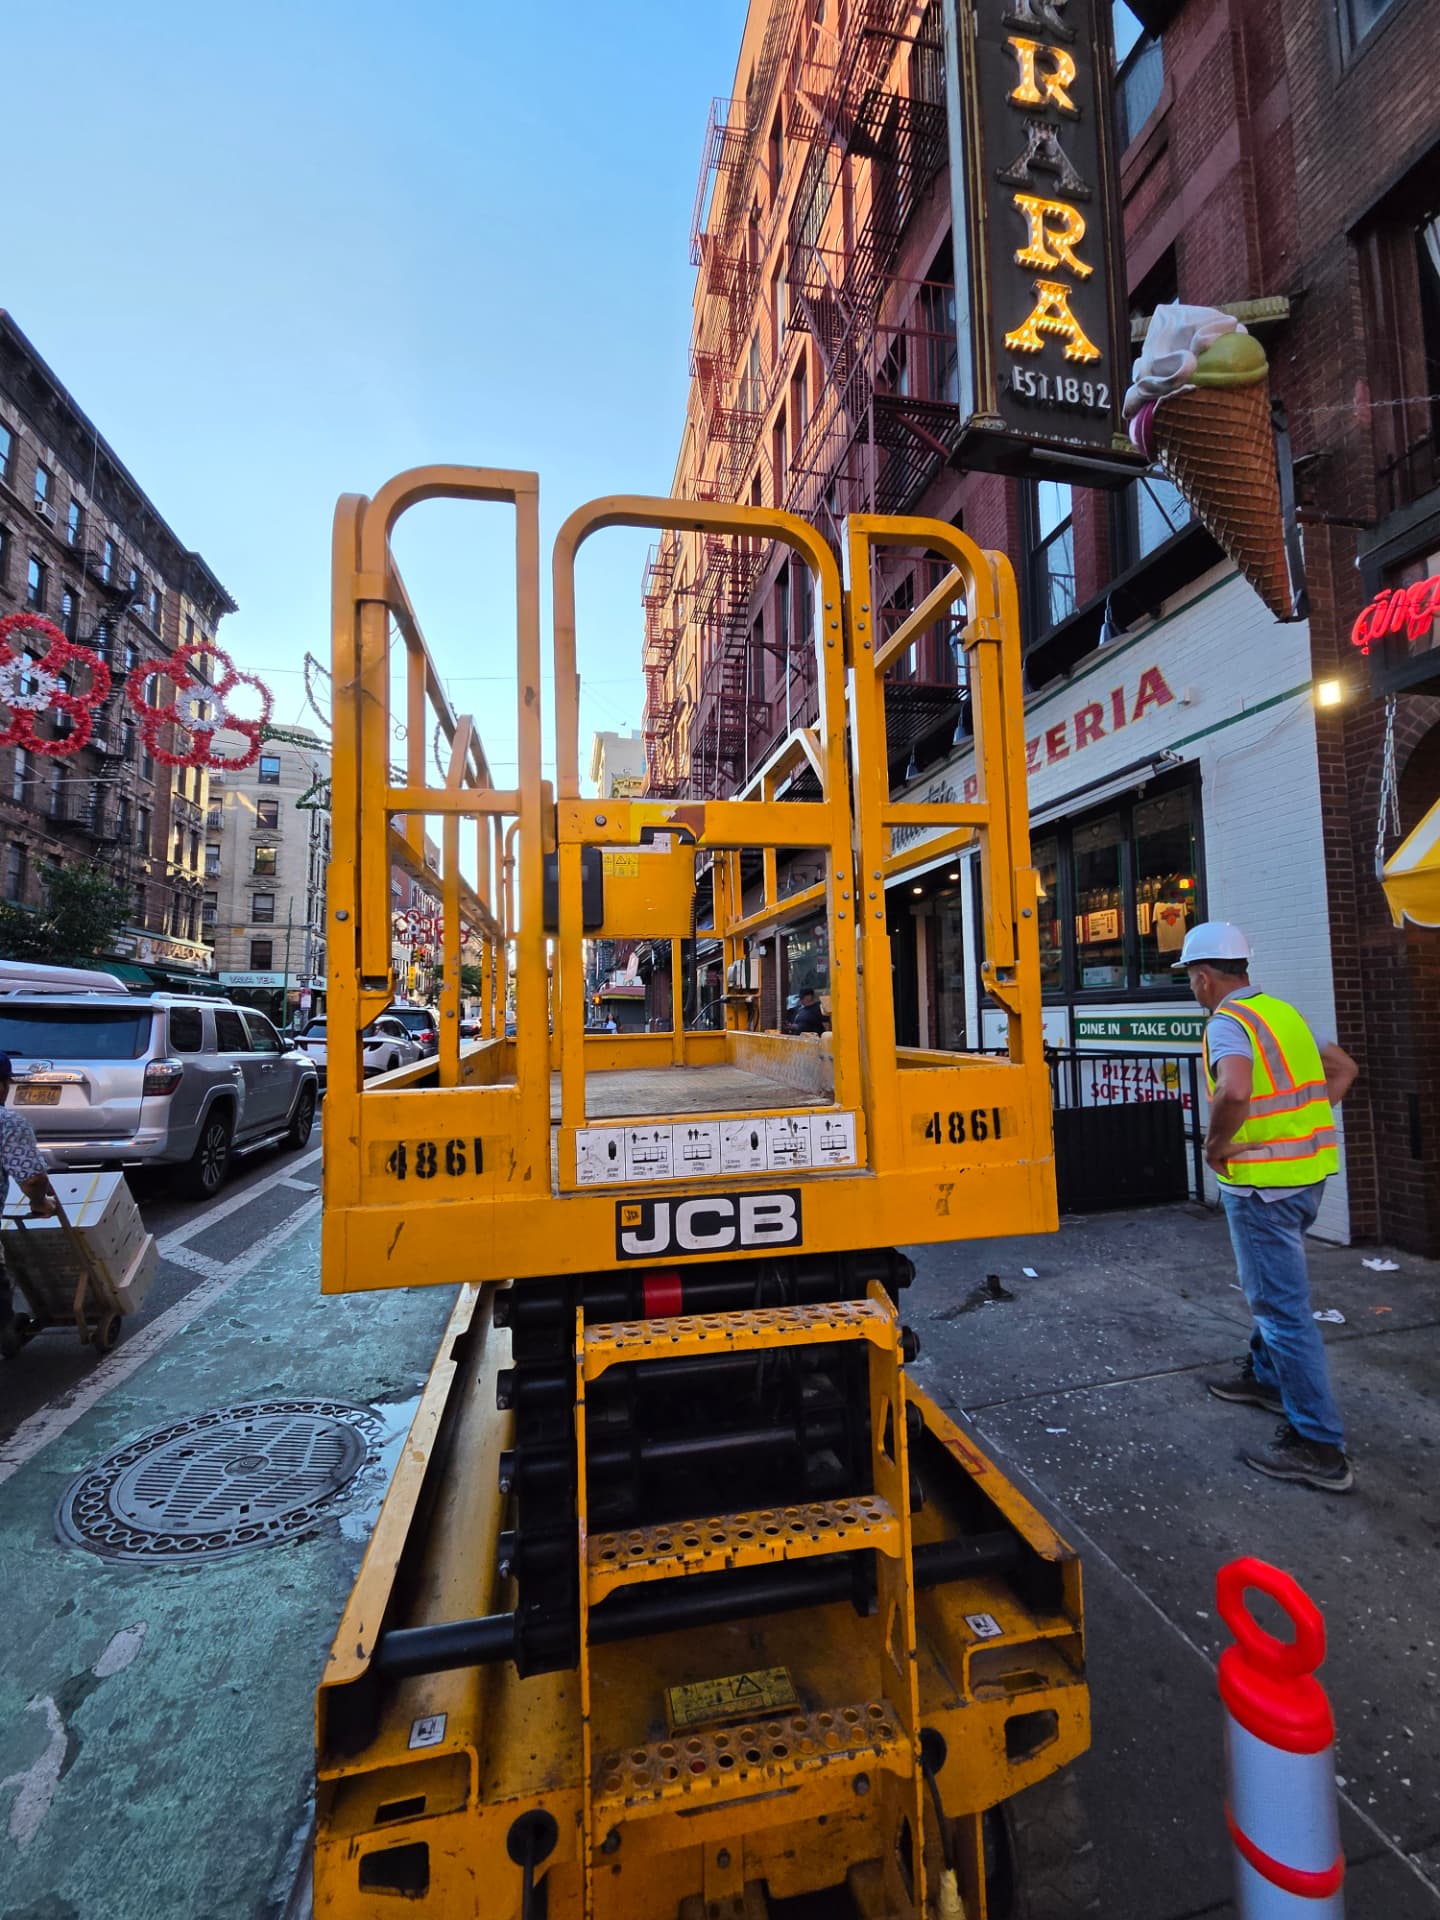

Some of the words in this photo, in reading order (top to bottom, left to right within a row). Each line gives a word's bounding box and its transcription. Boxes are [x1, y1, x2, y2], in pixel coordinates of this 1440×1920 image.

[963, 664, 1175, 804] PZERIA
[1080, 1023, 1106, 1035] DINE
[1108, 1023, 1120, 1035] IN
[1131, 1022, 1167, 1036] TAKE
[1170, 1022, 1203, 1036] OUT
[1102, 1064, 1159, 1084] PIZZA
[1091, 1082, 1131, 1102] SOFT
[925, 1107, 1002, 1144] 4861
[621, 1194, 798, 1255] JCB
